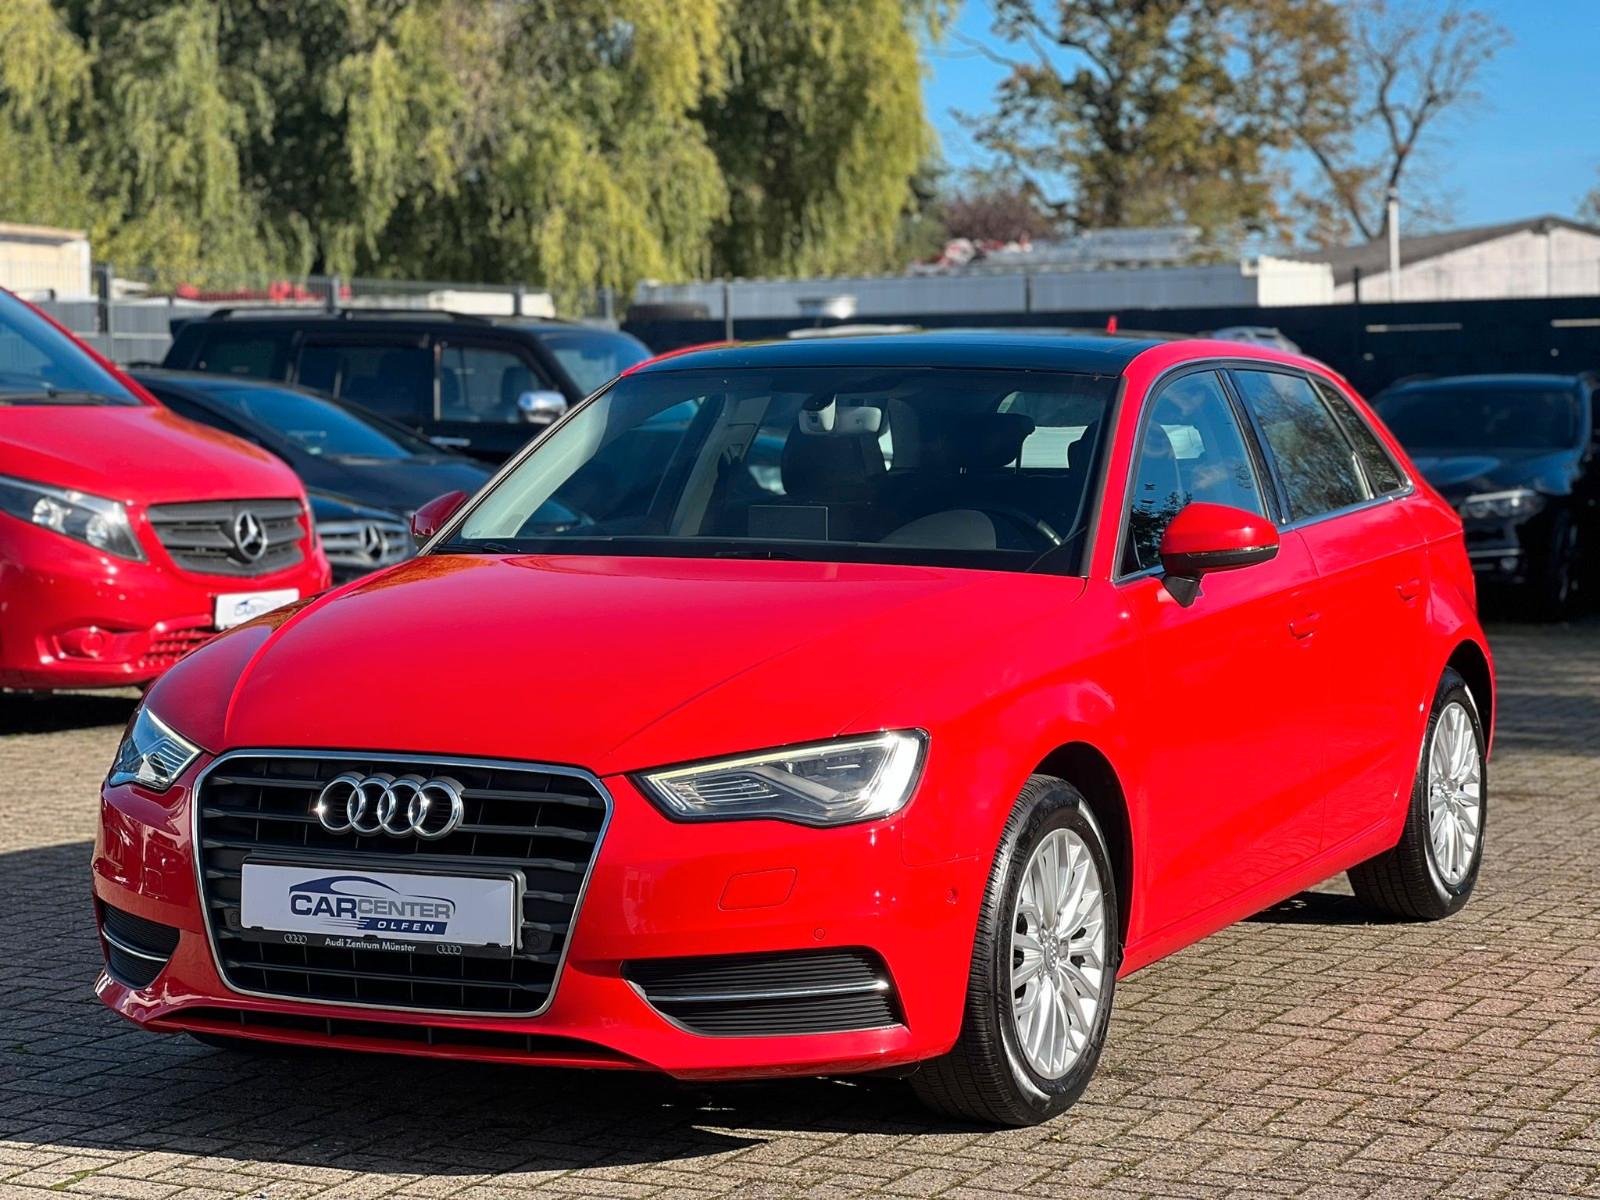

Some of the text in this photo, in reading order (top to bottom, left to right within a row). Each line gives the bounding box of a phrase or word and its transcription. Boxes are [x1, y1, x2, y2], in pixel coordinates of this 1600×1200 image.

[377, 921, 435, 932] OLFEN
[324, 937, 416, 952] Audi Zentrum Münster
